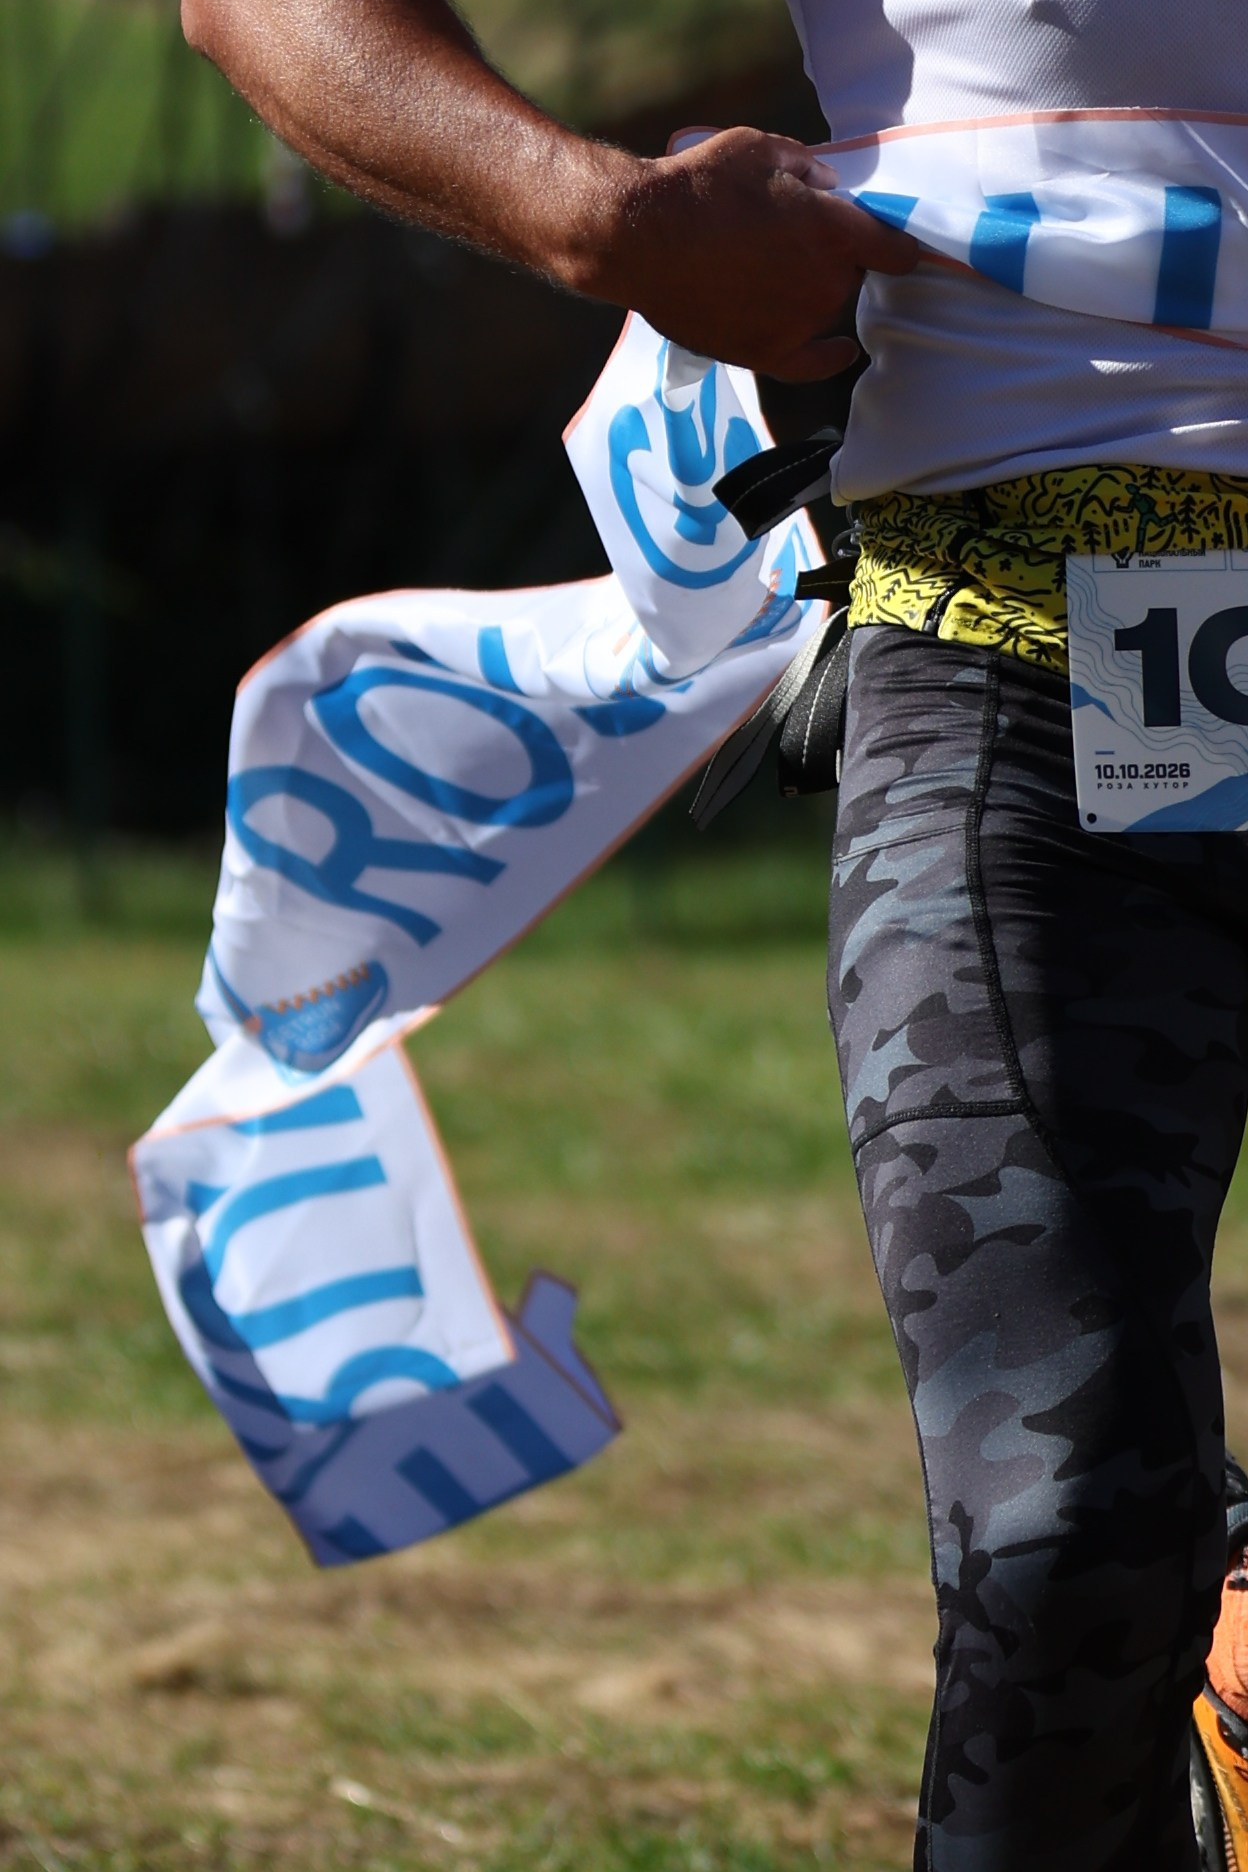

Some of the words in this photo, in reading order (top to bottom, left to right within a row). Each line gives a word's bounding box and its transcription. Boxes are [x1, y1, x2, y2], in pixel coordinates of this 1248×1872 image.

[1138, 559, 1161, 568] ПАРК
[1095, 763, 1191, 779] 10.10.2026
[1097, 782, 1134, 790] РОЗА
[1143, 781, 1189, 789] ХУТОР
